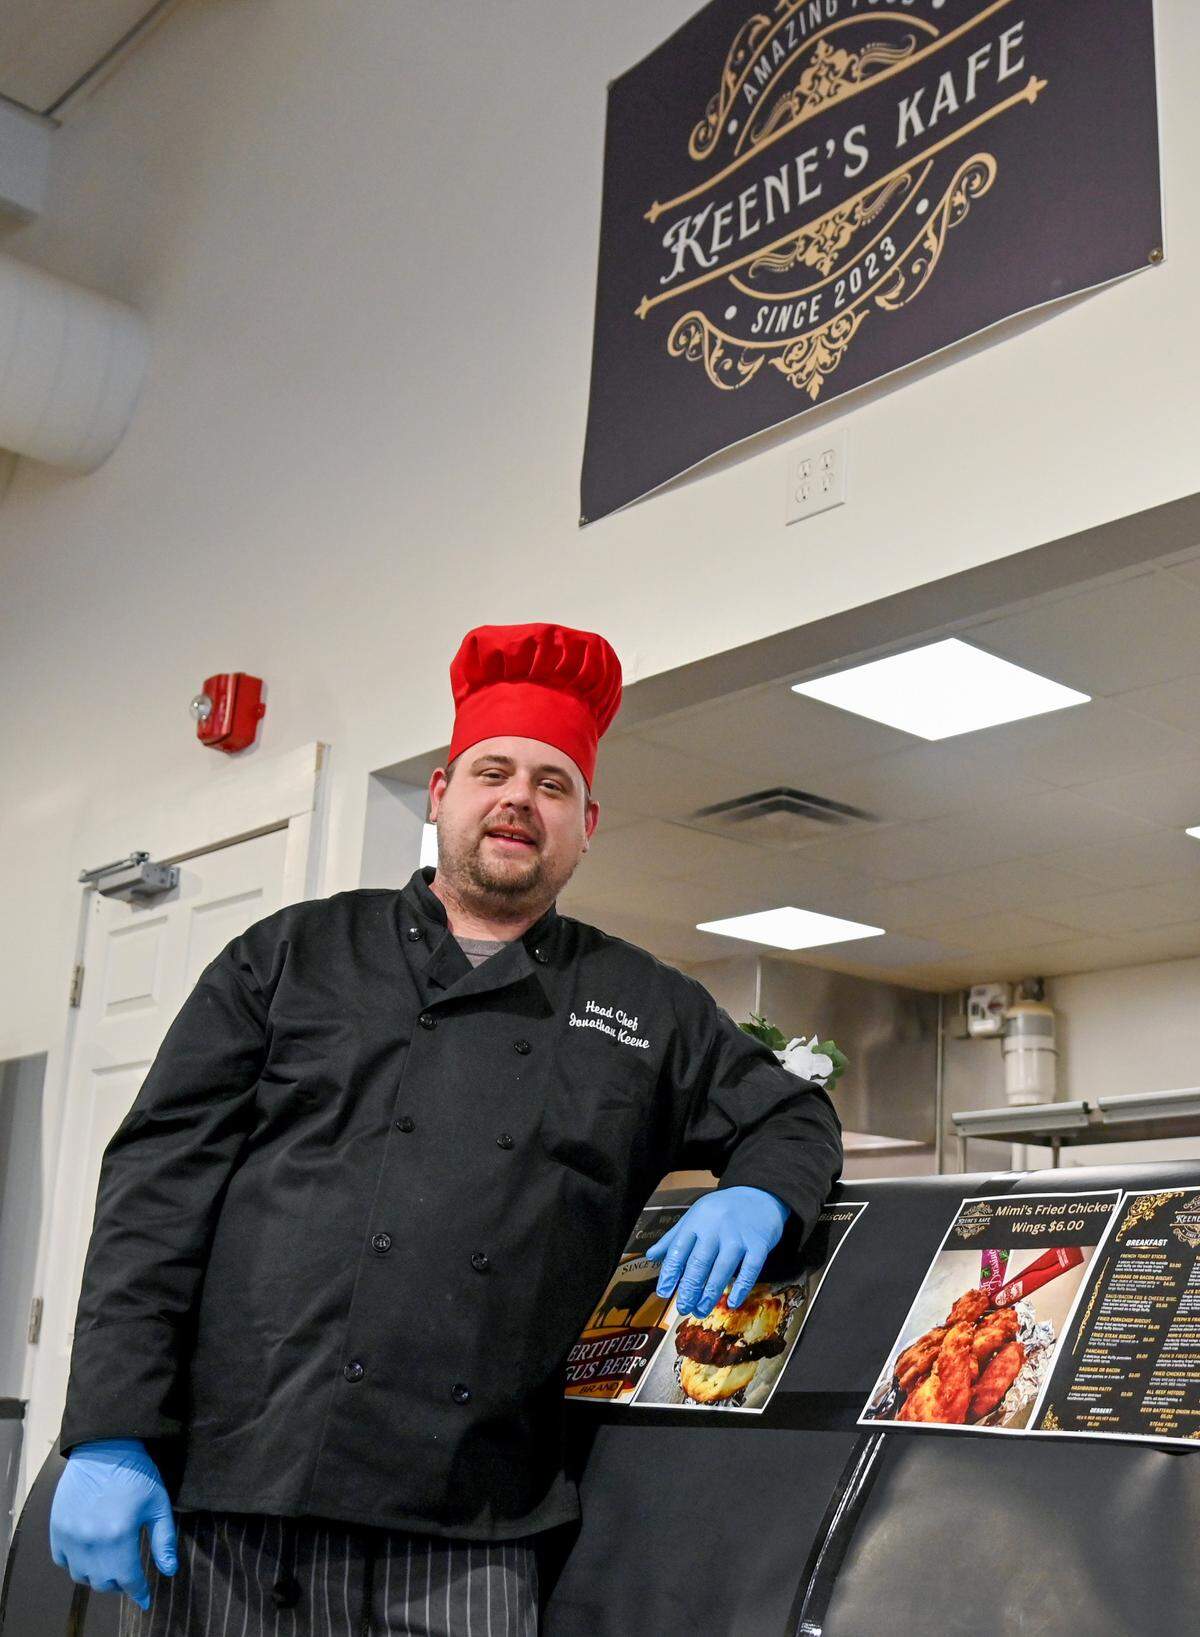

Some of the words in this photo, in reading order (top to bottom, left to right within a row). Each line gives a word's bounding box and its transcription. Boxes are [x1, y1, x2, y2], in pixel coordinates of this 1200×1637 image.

[660, 124, 869, 285] KEENE'S
[896, 20, 1025, 149] KAFE
[751, 294, 822, 334] SINCE
[834, 236, 896, 308] 2023
[585, 1000, 614, 1018] Head
[615, 1010, 639, 1031] Chef
[568, 1012, 617, 1037] Jonathan
[617, 1028, 650, 1049] Keene
[994, 1205, 1032, 1217] Mimi's
[1034, 1204, 1064, 1215] Fried
[1066, 1202, 1116, 1214] Chicken
[1011, 1221, 1046, 1235] Wings
[1048, 1219, 1084, 1232] $6.00
[1125, 1239, 1168, 1247] BREAKFAST
[622, 1260, 649, 1275] SINCE
[567, 1333, 649, 1362] ERTIFIED
